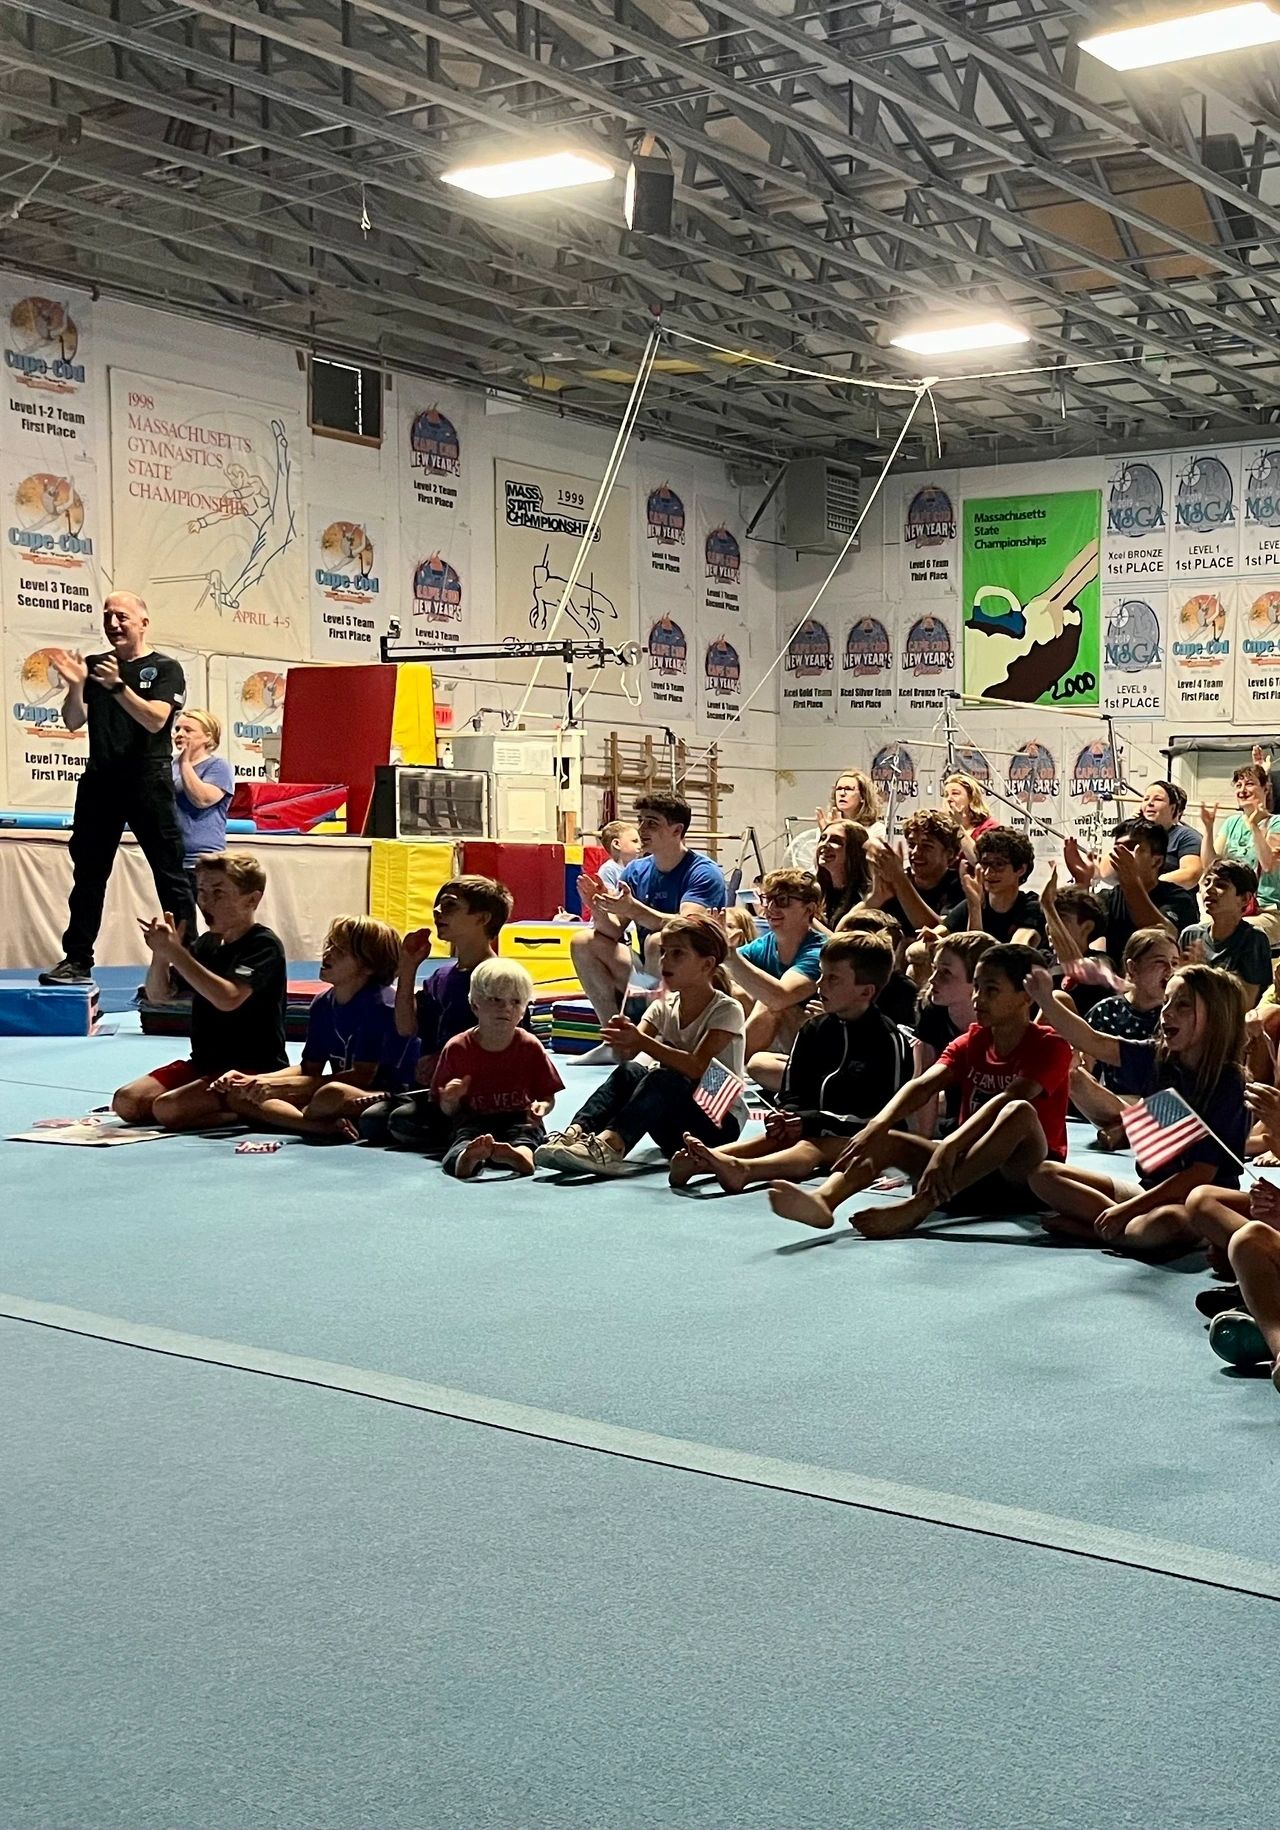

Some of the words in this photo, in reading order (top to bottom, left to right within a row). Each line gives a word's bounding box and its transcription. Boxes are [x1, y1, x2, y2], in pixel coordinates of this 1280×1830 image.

[128, 392, 154, 410] 1998
[10, 399, 35, 417] Level
[37, 404, 54, 419] 1-2
[56, 408, 85, 424] Team
[21, 418, 45, 434] First
[47, 422, 76, 439] Place
[128, 413, 252, 453] MASSACHUSETTS
[128, 438, 224, 469] GYMNASTICS
[128, 460, 172, 481] STATE
[414, 480, 430, 492] Level
[432, 484, 437, 493] 2
[438, 485, 457, 497] Team
[507, 484, 543, 500] MASS.
[129, 482, 249, 515] CHAMPIONSHIPS
[418, 493, 433, 505] First
[435, 497, 454, 508] Place
[557, 489, 584, 505] 1999
[507, 499, 540, 512] STATE
[974, 509, 1046, 524] Massachusetts
[904, 522, 924, 542] NEW
[924, 521, 956, 538] YEAR'S
[974, 525, 999, 536] State
[974, 536, 1046, 550] Championships
[1188, 546, 1213, 555] LEVEL
[1216, 545, 1220, 554] 1
[1108, 551, 1126, 561] Xcel
[1127, 548, 1163, 559] BRONZE
[1245, 555, 1264, 566] 1st
[1108, 564, 1124, 574] 1st
[1126, 562, 1164, 572] PLACE
[1176, 559, 1192, 570] 1st
[1194, 557, 1234, 569] PLACE
[20, 578, 48, 592] Level
[51, 582, 58, 594] 3
[60, 582, 89, 596] Team
[18, 595, 59, 610] Second
[61, 600, 92, 614] Place
[232, 610, 269, 626] APRIL
[272, 616, 290, 628] 4-5
[323, 613, 344, 626] Level
[346, 616, 351, 627] 5
[353, 617, 375, 629] Team
[329, 627, 347, 639] First
[349, 631, 371, 642] Place
[1172, 640, 1229, 656] Cape-Cod
[785, 654, 804, 671] NEW
[804, 653, 834, 670] YEAR'S
[843, 653, 862, 670] NEW
[862, 652, 893, 669] YEAR'S
[902, 652, 922, 669] NEW
[923, 652, 954, 668] YEAR'S
[1117, 685, 1141, 694] LEVEL
[1142, 684, 1147, 693] 9
[1177, 679, 1196, 689] Level
[1198, 679, 1202, 688] 4
[1203, 679, 1223, 688] Team
[1248, 678, 1267, 687] Level
[1268, 678, 1274, 687] 6
[1104, 698, 1121, 709] 1st
[1122, 697, 1160, 708] PLACE
[1181, 692, 1198, 701] First
[1199, 692, 1219, 701] Place
[1253, 690, 1270, 700] First
[1070, 779, 1092, 797] NEW
[968, 1066, 995, 1089] TEAM
[493, 1089, 532, 1107] VEGA
